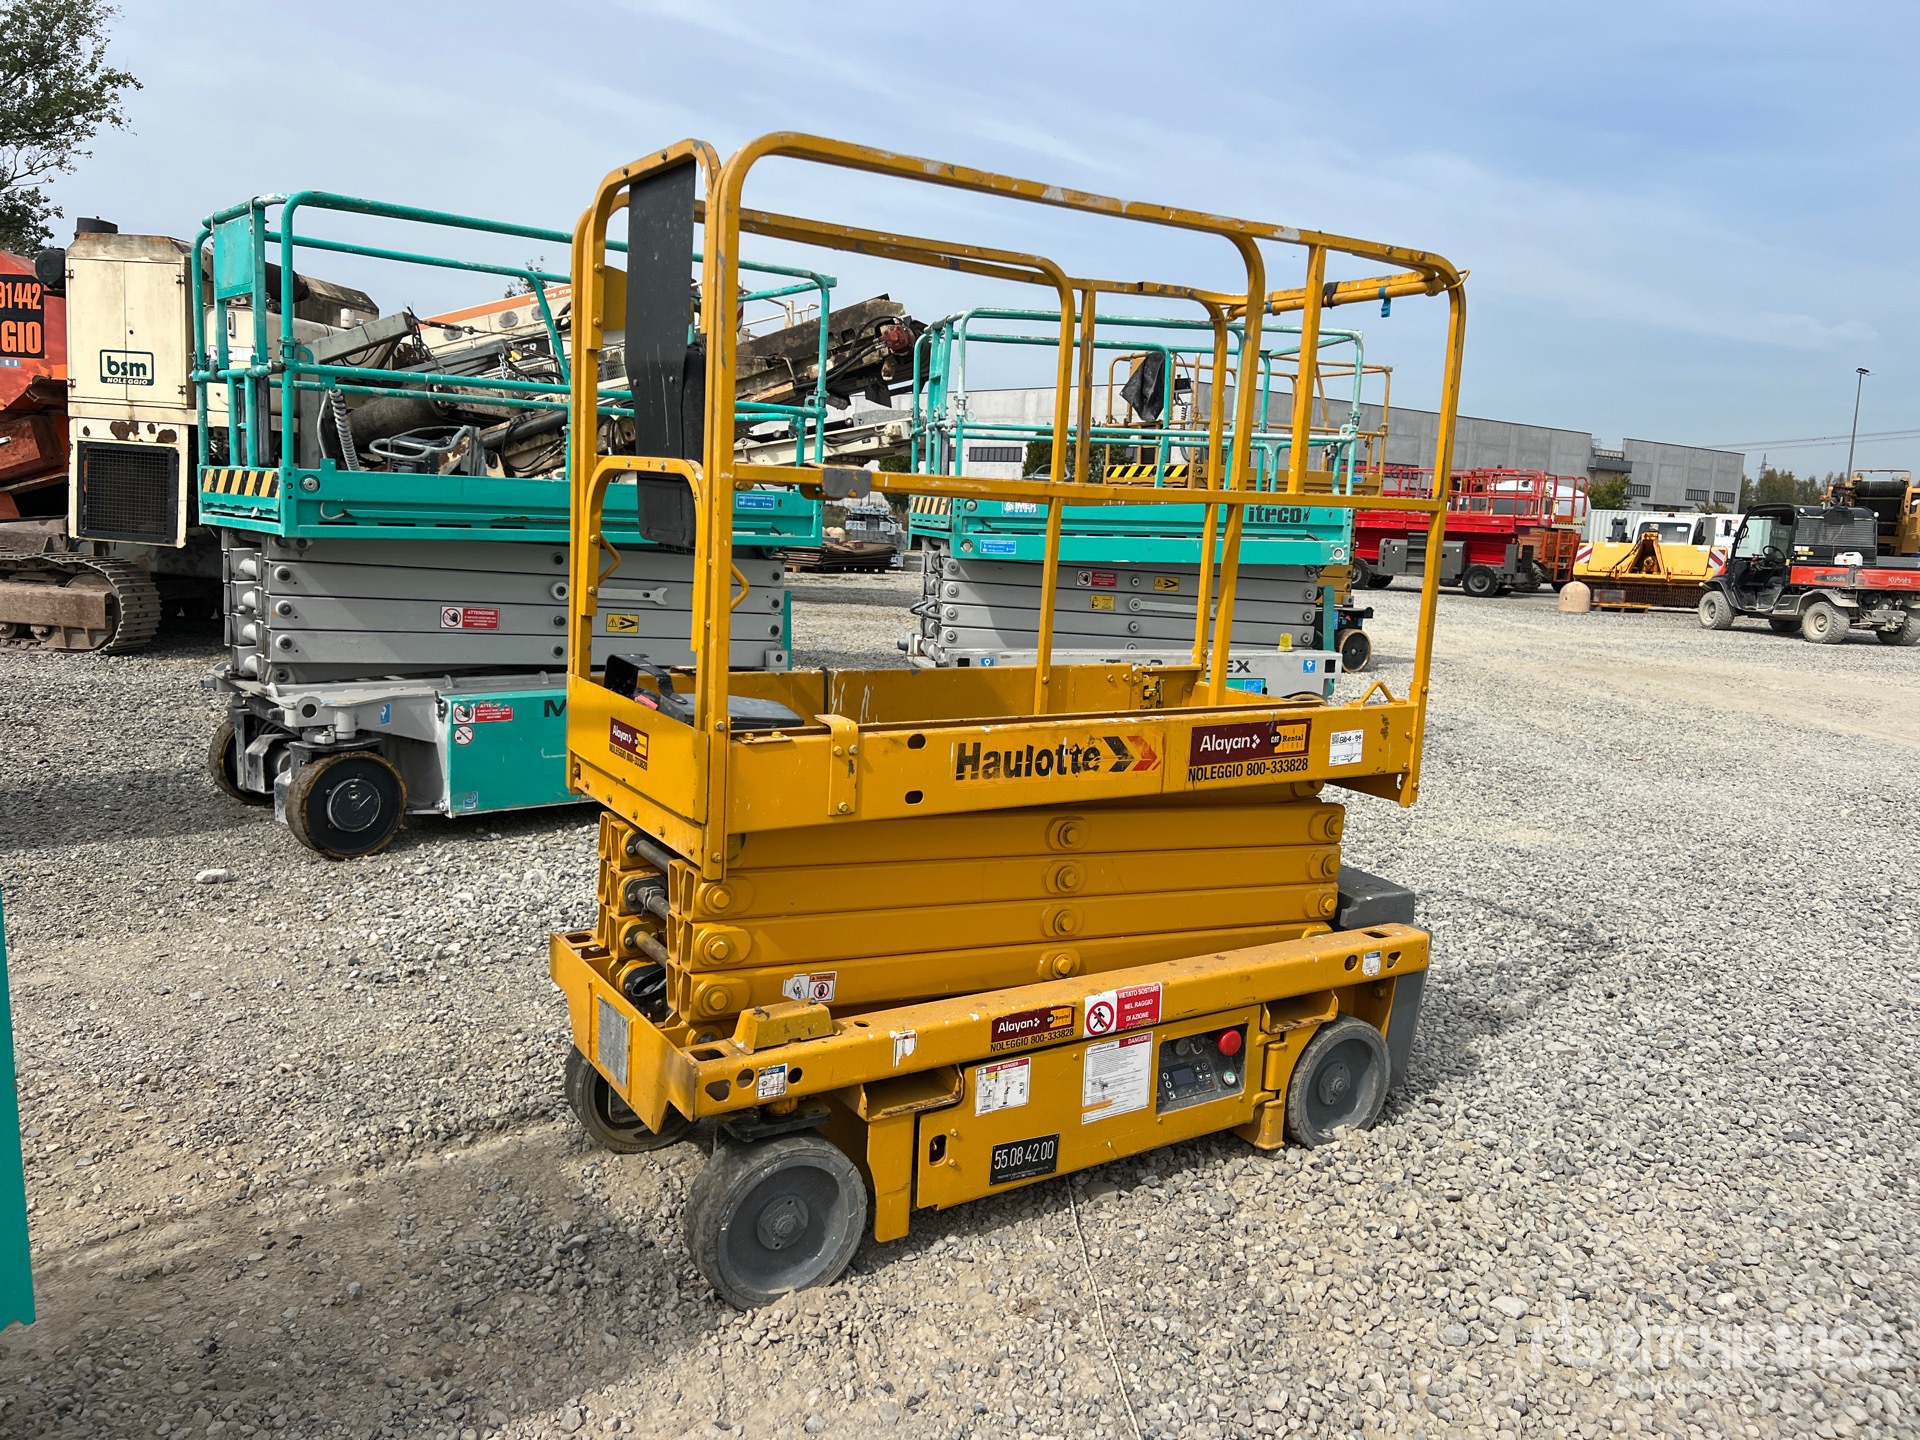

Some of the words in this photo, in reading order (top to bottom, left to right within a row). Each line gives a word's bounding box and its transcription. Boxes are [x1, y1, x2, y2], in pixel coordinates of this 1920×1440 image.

[107, 355, 147, 377] bsm
[107, 377, 148, 386] NOLEGGIO
[1200, 734, 1251, 755] Alayan
[1282, 734, 1304, 743] Rental
[955, 742, 1101, 781] Haulotte
[1188, 763, 1243, 782] NOLEGGIO
[1246, 758, 1309, 776] 800-333828
[1118, 990, 1137, 999] VIETATO
[1138, 985, 1160, 995] SOSTARE
[1134, 999, 1154, 1008] RAGGIO
[1132, 1011, 1149, 1020] AZIONE
[997, 1019, 1033, 1033] Alayan
[990, 1037, 1028, 1053] NOLEGGIO
[1030, 1028, 1075, 1044] 800-333828
[1128, 1035, 1148, 1045] DANGER
